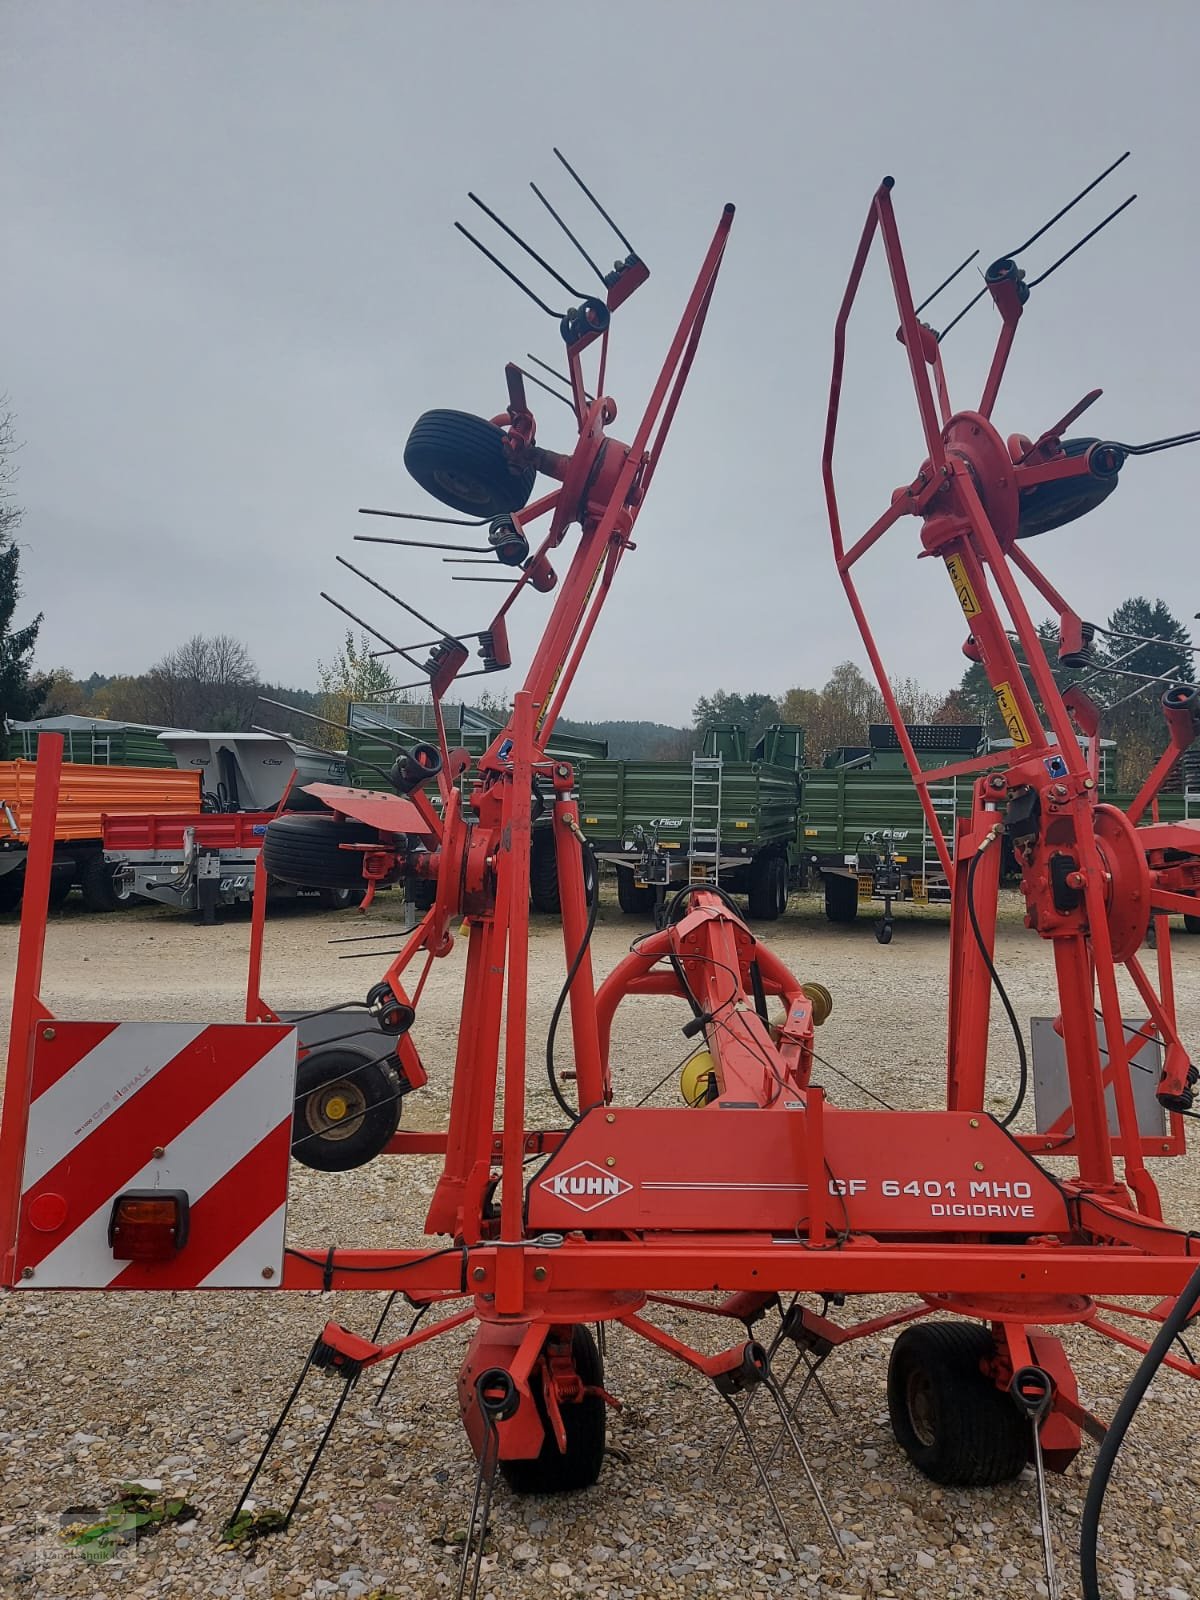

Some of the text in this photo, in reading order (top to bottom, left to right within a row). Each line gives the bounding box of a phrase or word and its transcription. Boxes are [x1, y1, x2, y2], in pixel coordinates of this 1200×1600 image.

[553, 1175, 620, 1196] KUHN
[828, 1179, 1032, 1198] GF 6401 MHO
[930, 1203, 1035, 1217] DIGIDRIVE
